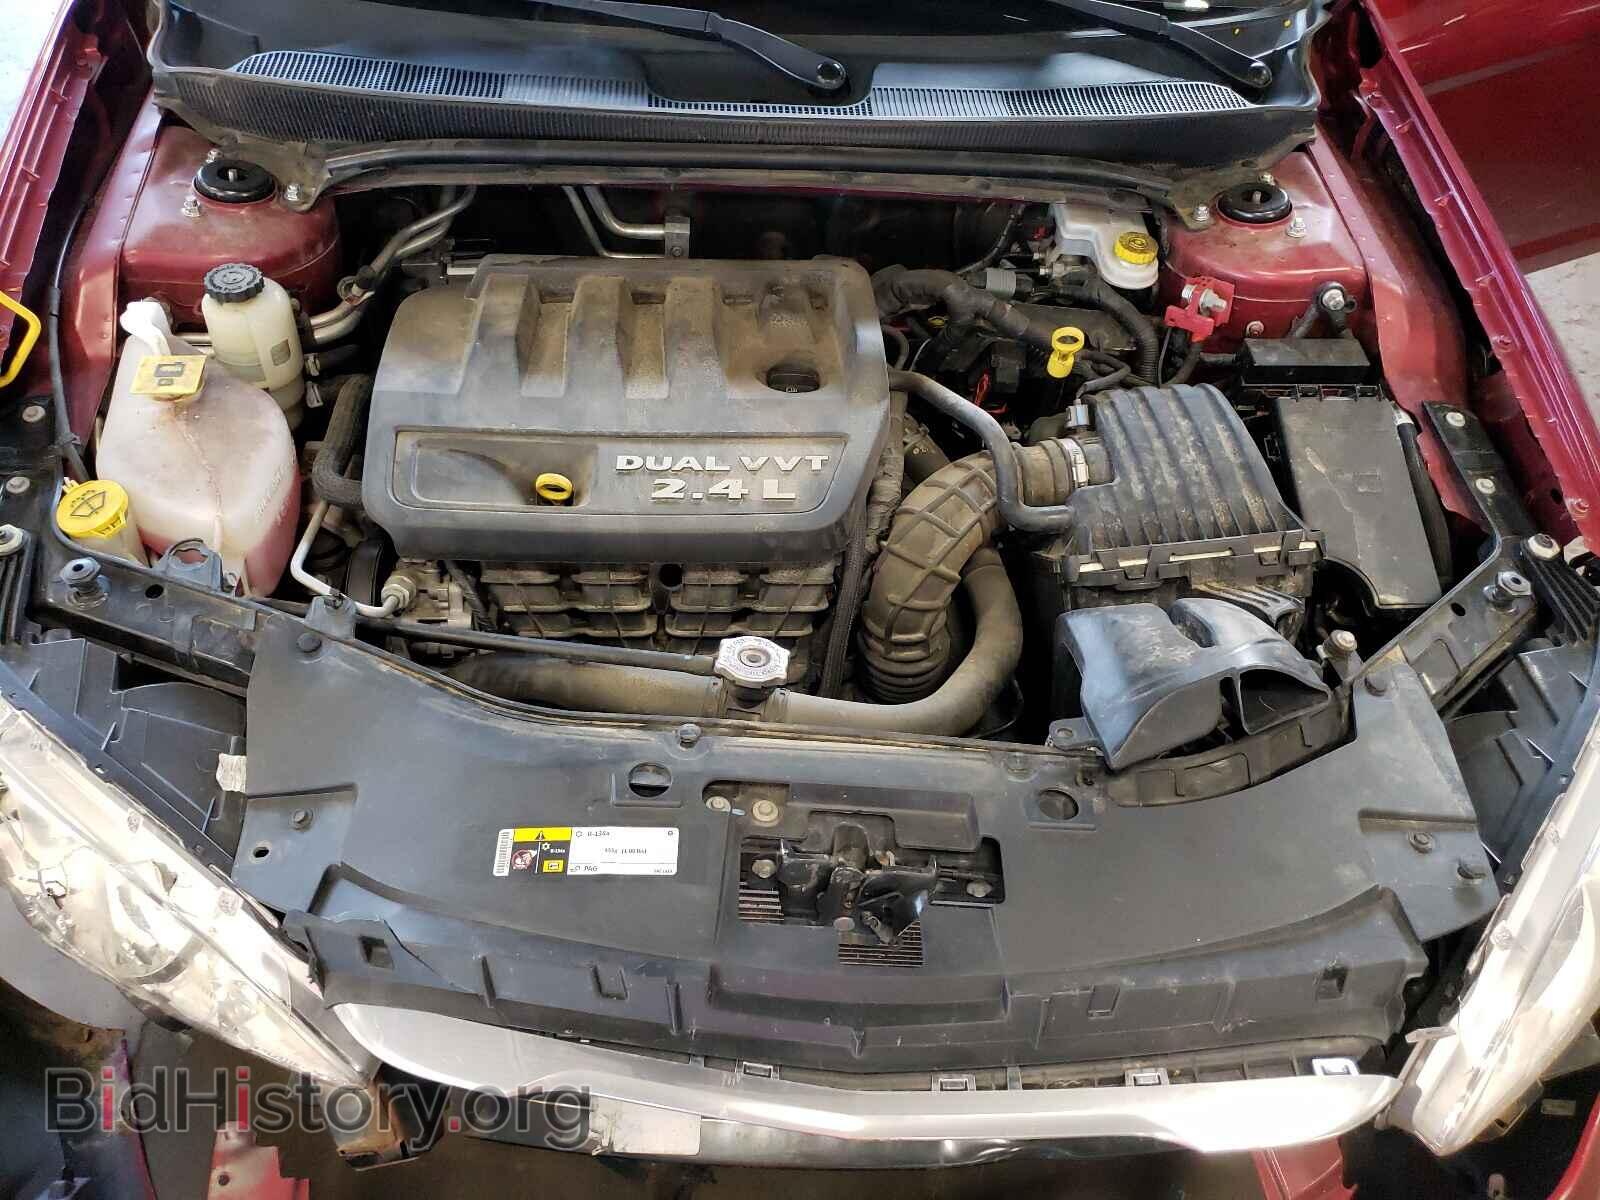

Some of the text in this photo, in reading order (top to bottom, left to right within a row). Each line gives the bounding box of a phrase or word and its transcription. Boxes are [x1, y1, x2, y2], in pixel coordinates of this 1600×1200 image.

[615, 455, 830, 472] DUAL VVT
[584, 865, 598, 873] PAG
